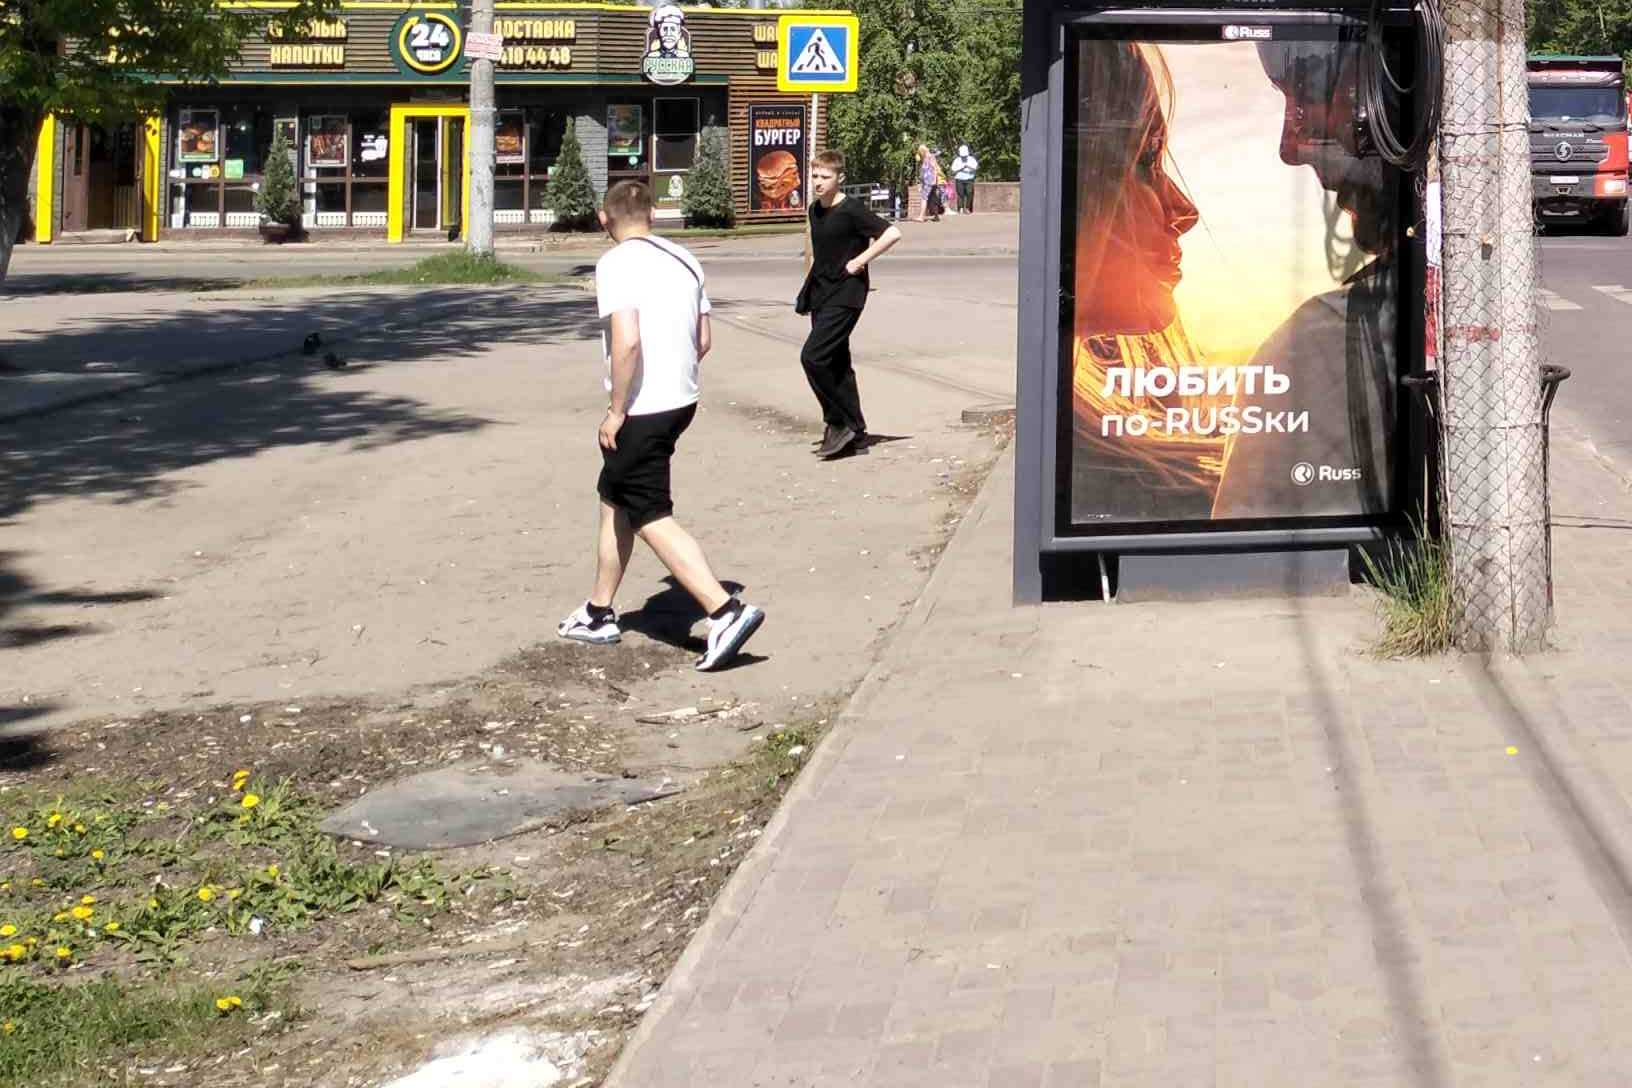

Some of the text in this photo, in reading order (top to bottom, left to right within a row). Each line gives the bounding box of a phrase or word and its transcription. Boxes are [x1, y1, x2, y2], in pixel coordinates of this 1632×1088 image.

[410, 24, 449, 46] 24
[271, 44, 344, 64] НАПИТКИ
[755, 129, 801, 146] БУРГЕР
[1102, 365, 1290, 398] ЛЮБИТЬ
[1101, 407, 1309, 437] по-RUSSки
[1319, 465, 1362, 481] Russ
